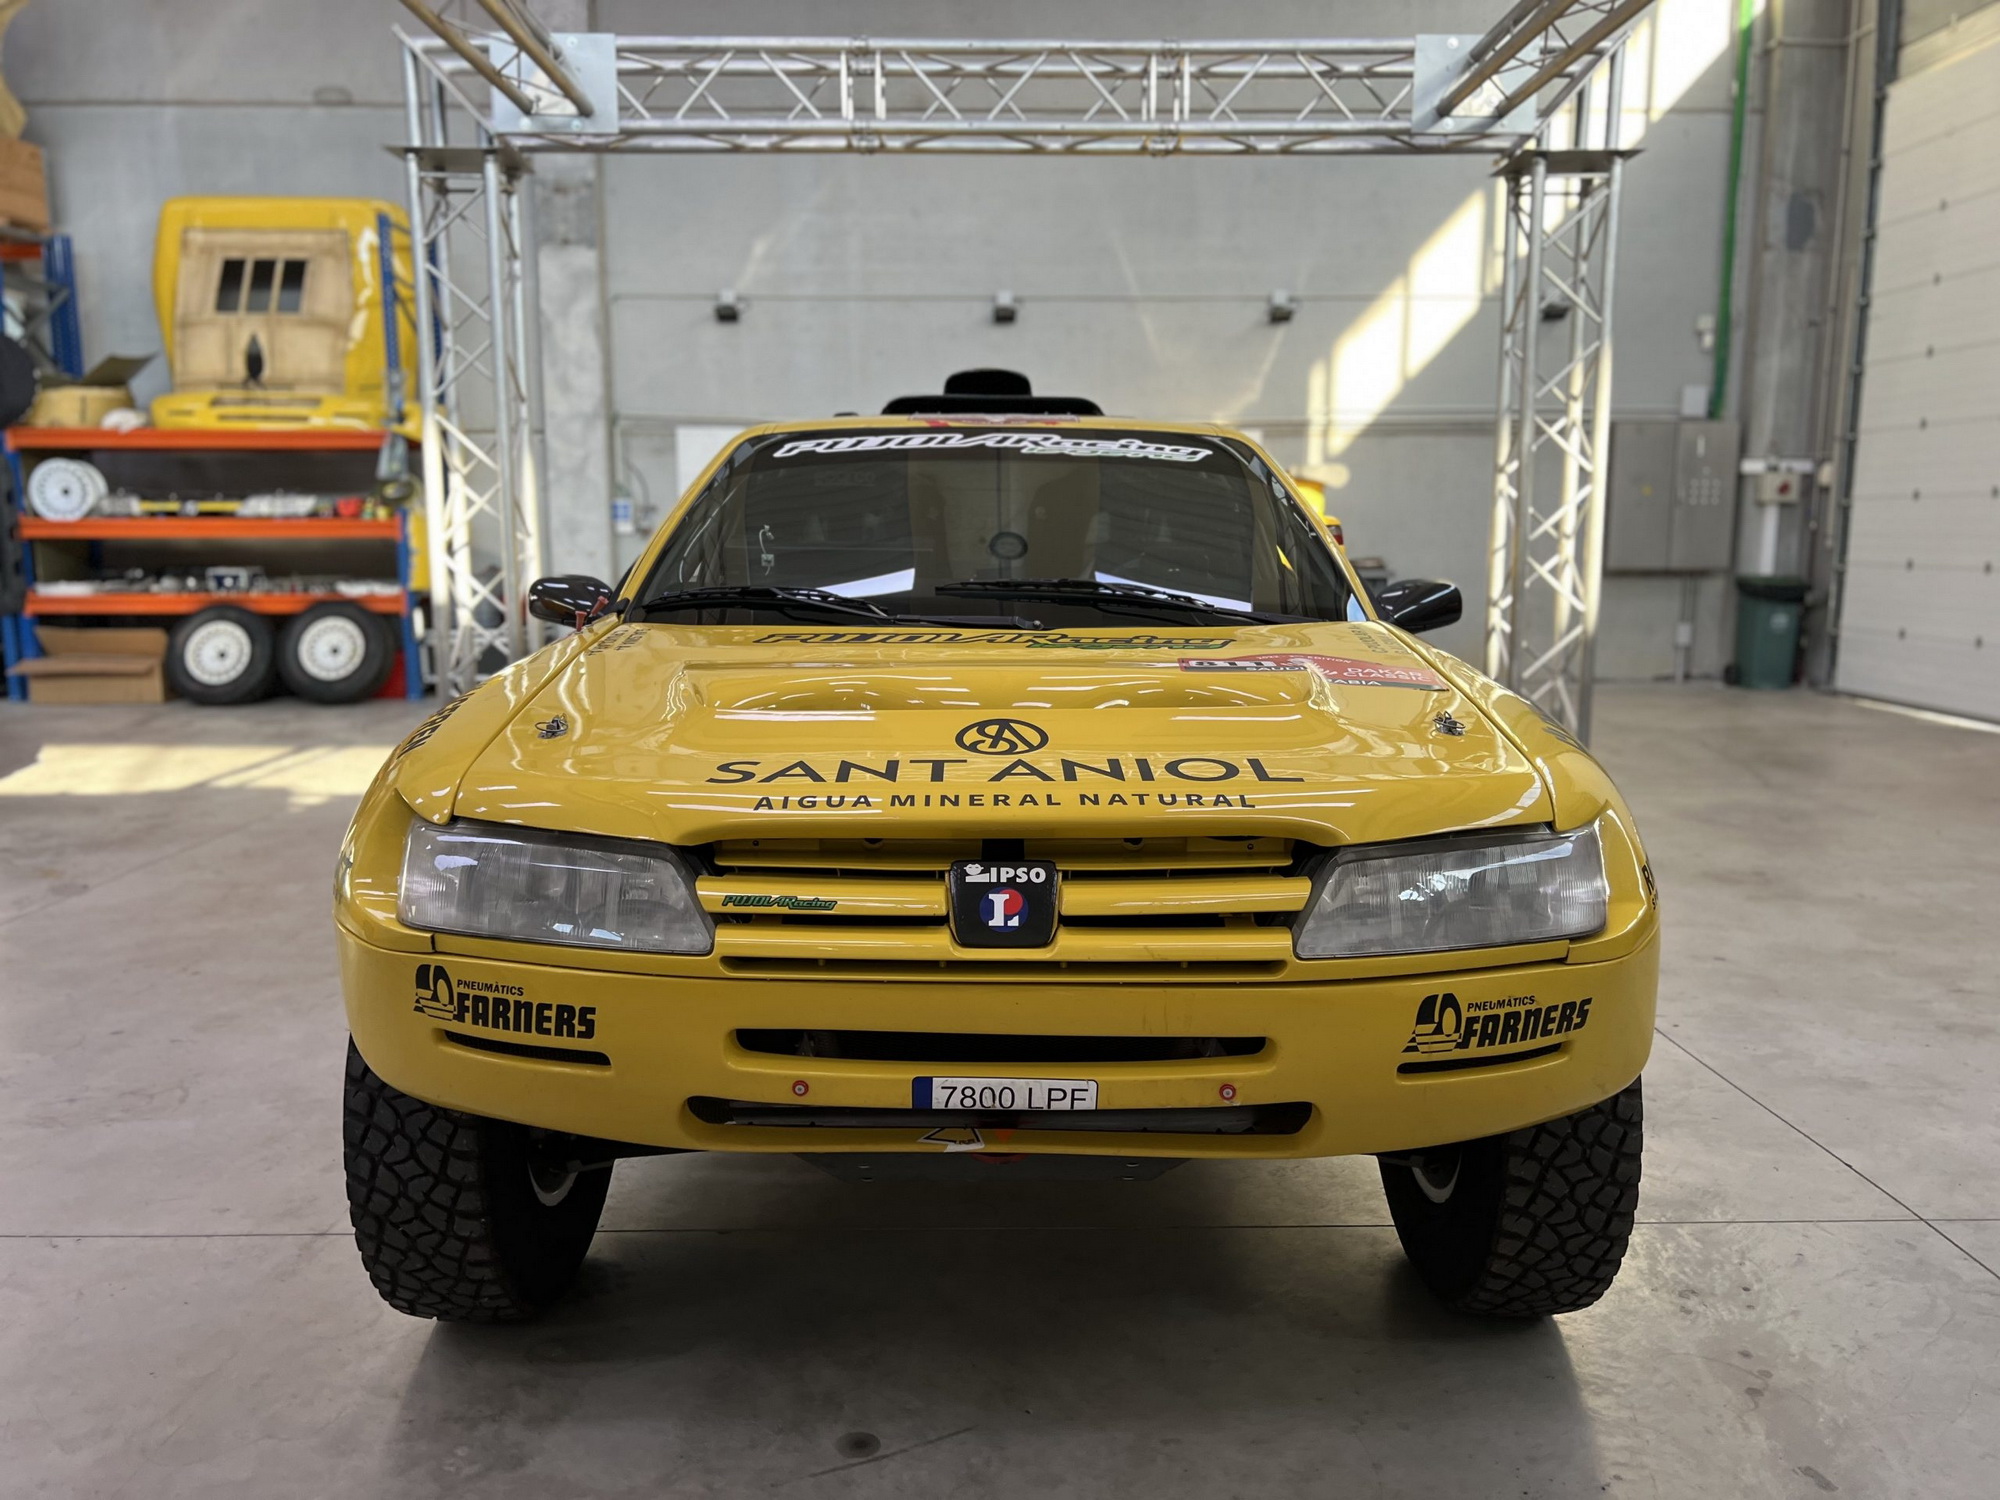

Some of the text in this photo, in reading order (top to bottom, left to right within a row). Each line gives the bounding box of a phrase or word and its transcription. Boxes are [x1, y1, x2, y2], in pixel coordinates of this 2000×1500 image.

[704, 758, 1305, 784] SANT ANIOL
[752, 793, 1256, 811] AIGUA MINERAL NATURAL
[940, 1086, 1089, 1110] 7800 LPF
